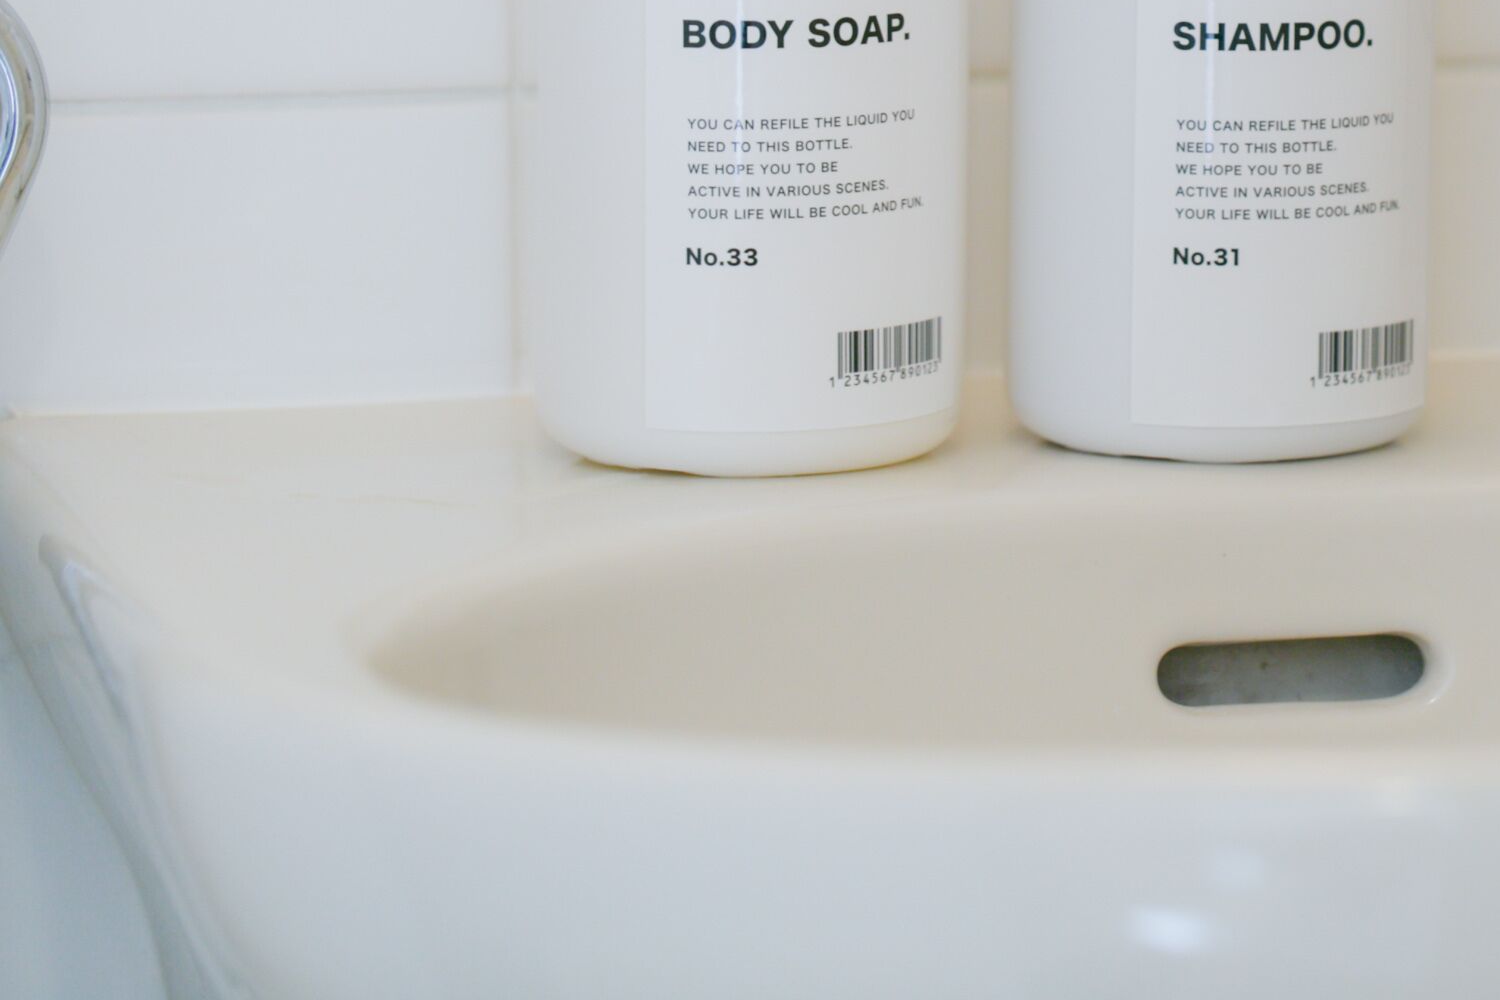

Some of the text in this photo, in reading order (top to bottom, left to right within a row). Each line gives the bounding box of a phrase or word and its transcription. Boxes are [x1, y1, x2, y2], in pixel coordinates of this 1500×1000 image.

[683, 13, 909, 49] BODY SOAP.
[1173, 19, 1372, 51] SHAMPOO.
[688, 109, 915, 130] YOU CAN REFILE THE LIQUID YOU
[1177, 112, 1394, 131] YOU CAN REFILE THE LIQUID YOU
[688, 138, 852, 153] NEED TO THIS BOTTLE.
[1176, 140, 1336, 154] NEED TO THIS BOTTLE.
[688, 161, 838, 175] WE HOPE YOU TO BE
[1176, 163, 1323, 176] WE HOPE YOU TO BE
[688, 179, 888, 198] ACTIVE IN VARIOUS SCENES.
[1175, 181, 1368, 198] ACTIVE IN VARIOUS SCENES.
[688, 196, 923, 220] YOUR LIFE WILL BE COOL AND FUN.
[1175, 208, 1216, 220] YOUR
[1221, 209, 1250, 220] LIFE
[1256, 208, 1289, 220] WILL
[1294, 208, 1311, 219] BE
[1315, 205, 1350, 218] COOL
[1353, 202, 1377, 215] AND
[686, 248, 758, 266] No.33
[1173, 247, 1239, 266] No.31
